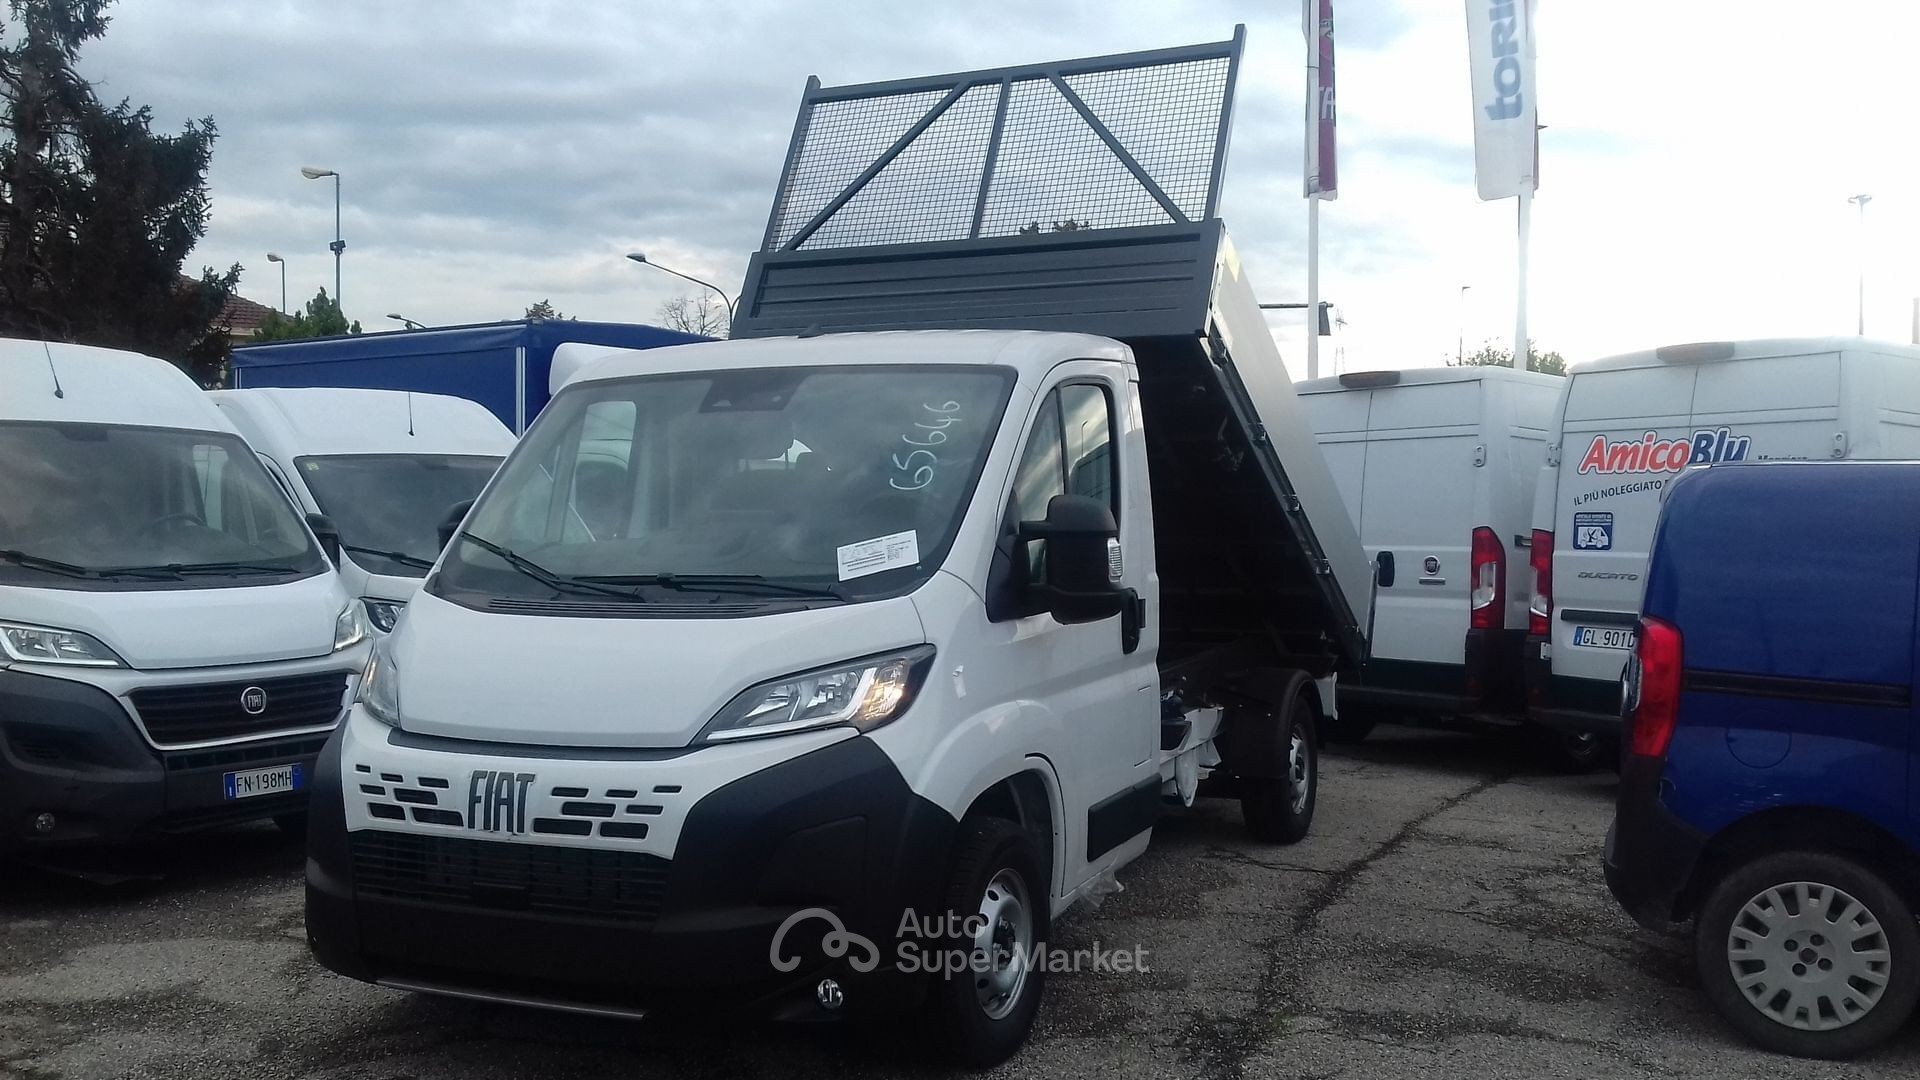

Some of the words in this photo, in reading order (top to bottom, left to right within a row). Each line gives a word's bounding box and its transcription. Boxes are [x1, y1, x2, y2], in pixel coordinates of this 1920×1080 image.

[889, 400, 963, 490] 65646
[1577, 427, 1751, 475] AmicoBlu
[1574, 496, 1582, 506] IL
[1601, 480, 1662, 499] NOLEGGIATO
[1578, 572, 1639, 580] DUCATO
[1583, 629, 1597, 645] GL
[247, 695, 262, 708] FIAT
[236, 777, 251, 793] FN
[256, 771, 292, 790] 198MH
[467, 770, 536, 834] FIAT
